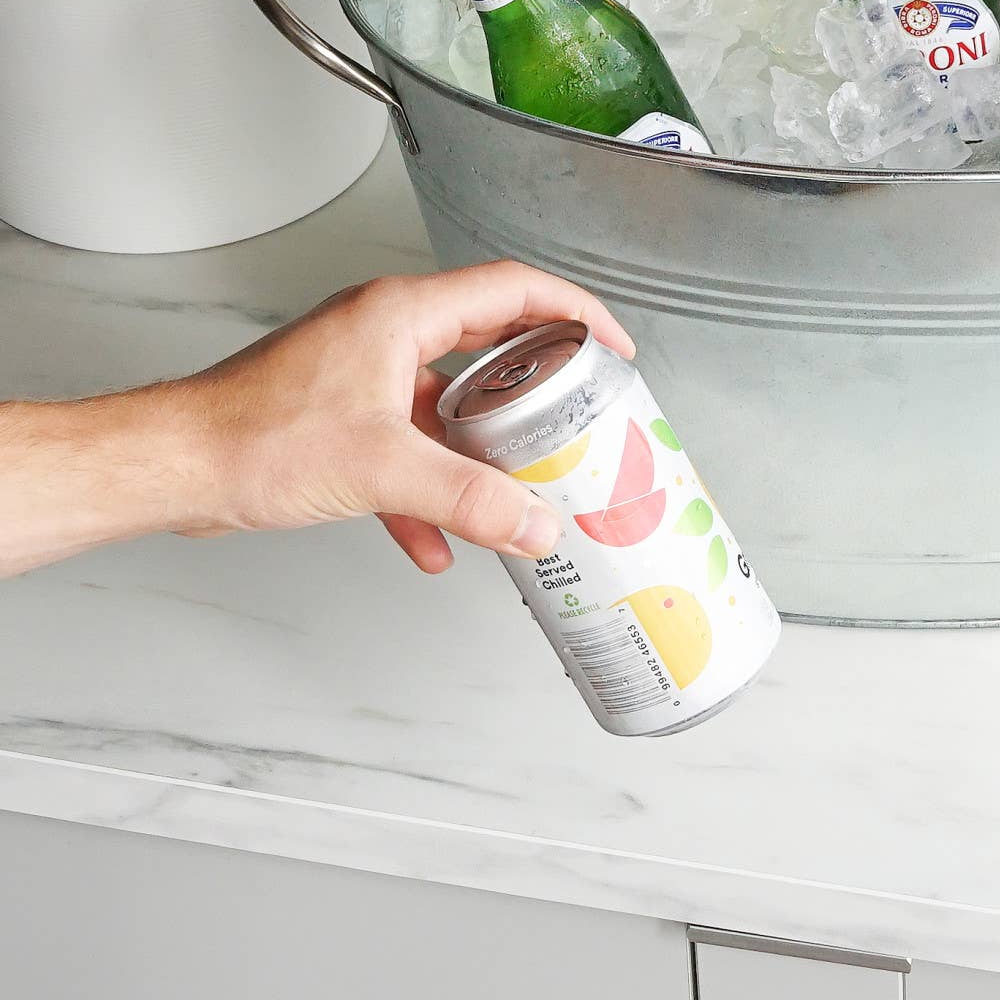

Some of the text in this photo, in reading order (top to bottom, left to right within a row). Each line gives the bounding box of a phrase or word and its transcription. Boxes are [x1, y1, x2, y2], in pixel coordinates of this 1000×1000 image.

[942, 5, 977, 20] SUPERIORE
[928, 31, 989, 71] ONI
[484, 424, 553, 460] Zero Calories
[535, 553, 561, 567] Best
[535, 560, 575, 578] Served
[542, 571, 582, 590] Chilled
[627, 624, 650, 656] 46553
[646, 657, 671, 690] 99482
